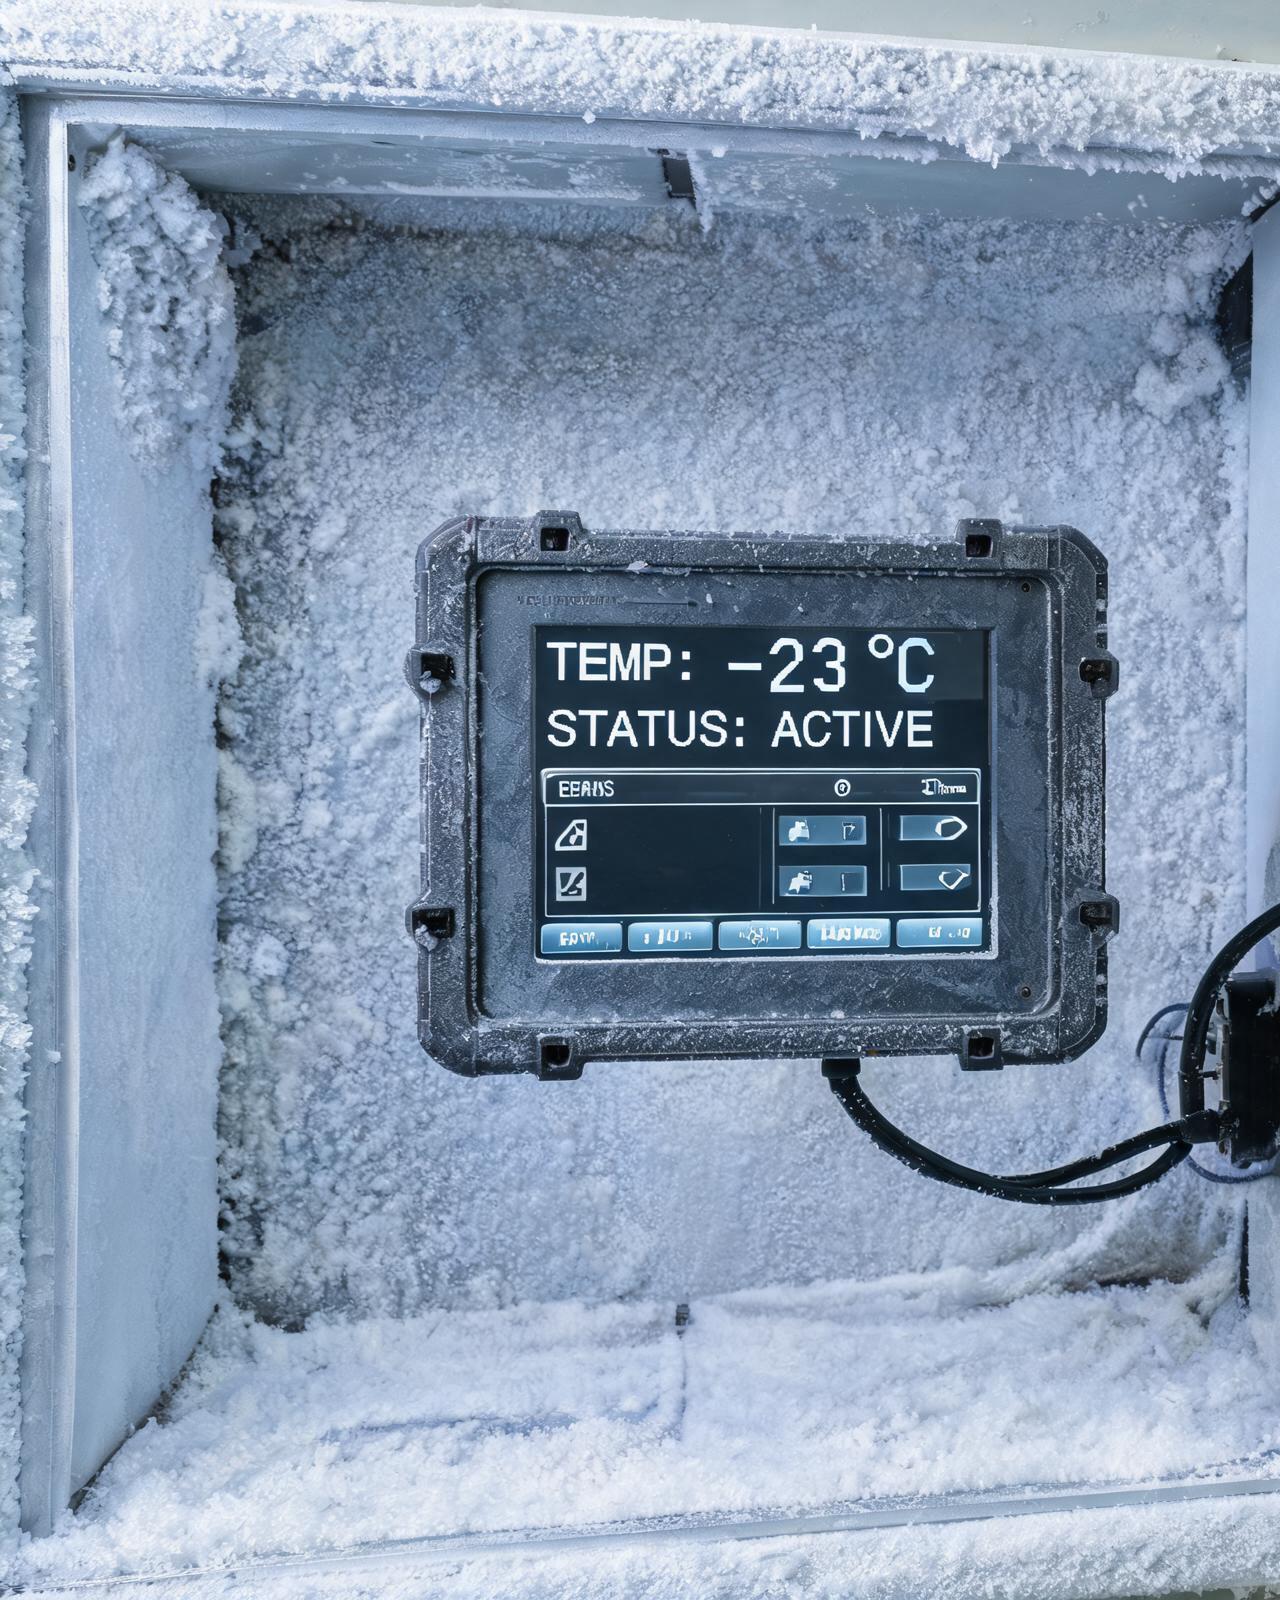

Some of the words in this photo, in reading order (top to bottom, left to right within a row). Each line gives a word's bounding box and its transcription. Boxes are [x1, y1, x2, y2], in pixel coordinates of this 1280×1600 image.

[546, 642, 691, 681] TEMP:
[727, 637, 846, 693] -23
[868, 633, 935, 693] °C
[547, 709, 744, 747] STATUS:
[771, 710, 934, 747] ACTIVE
